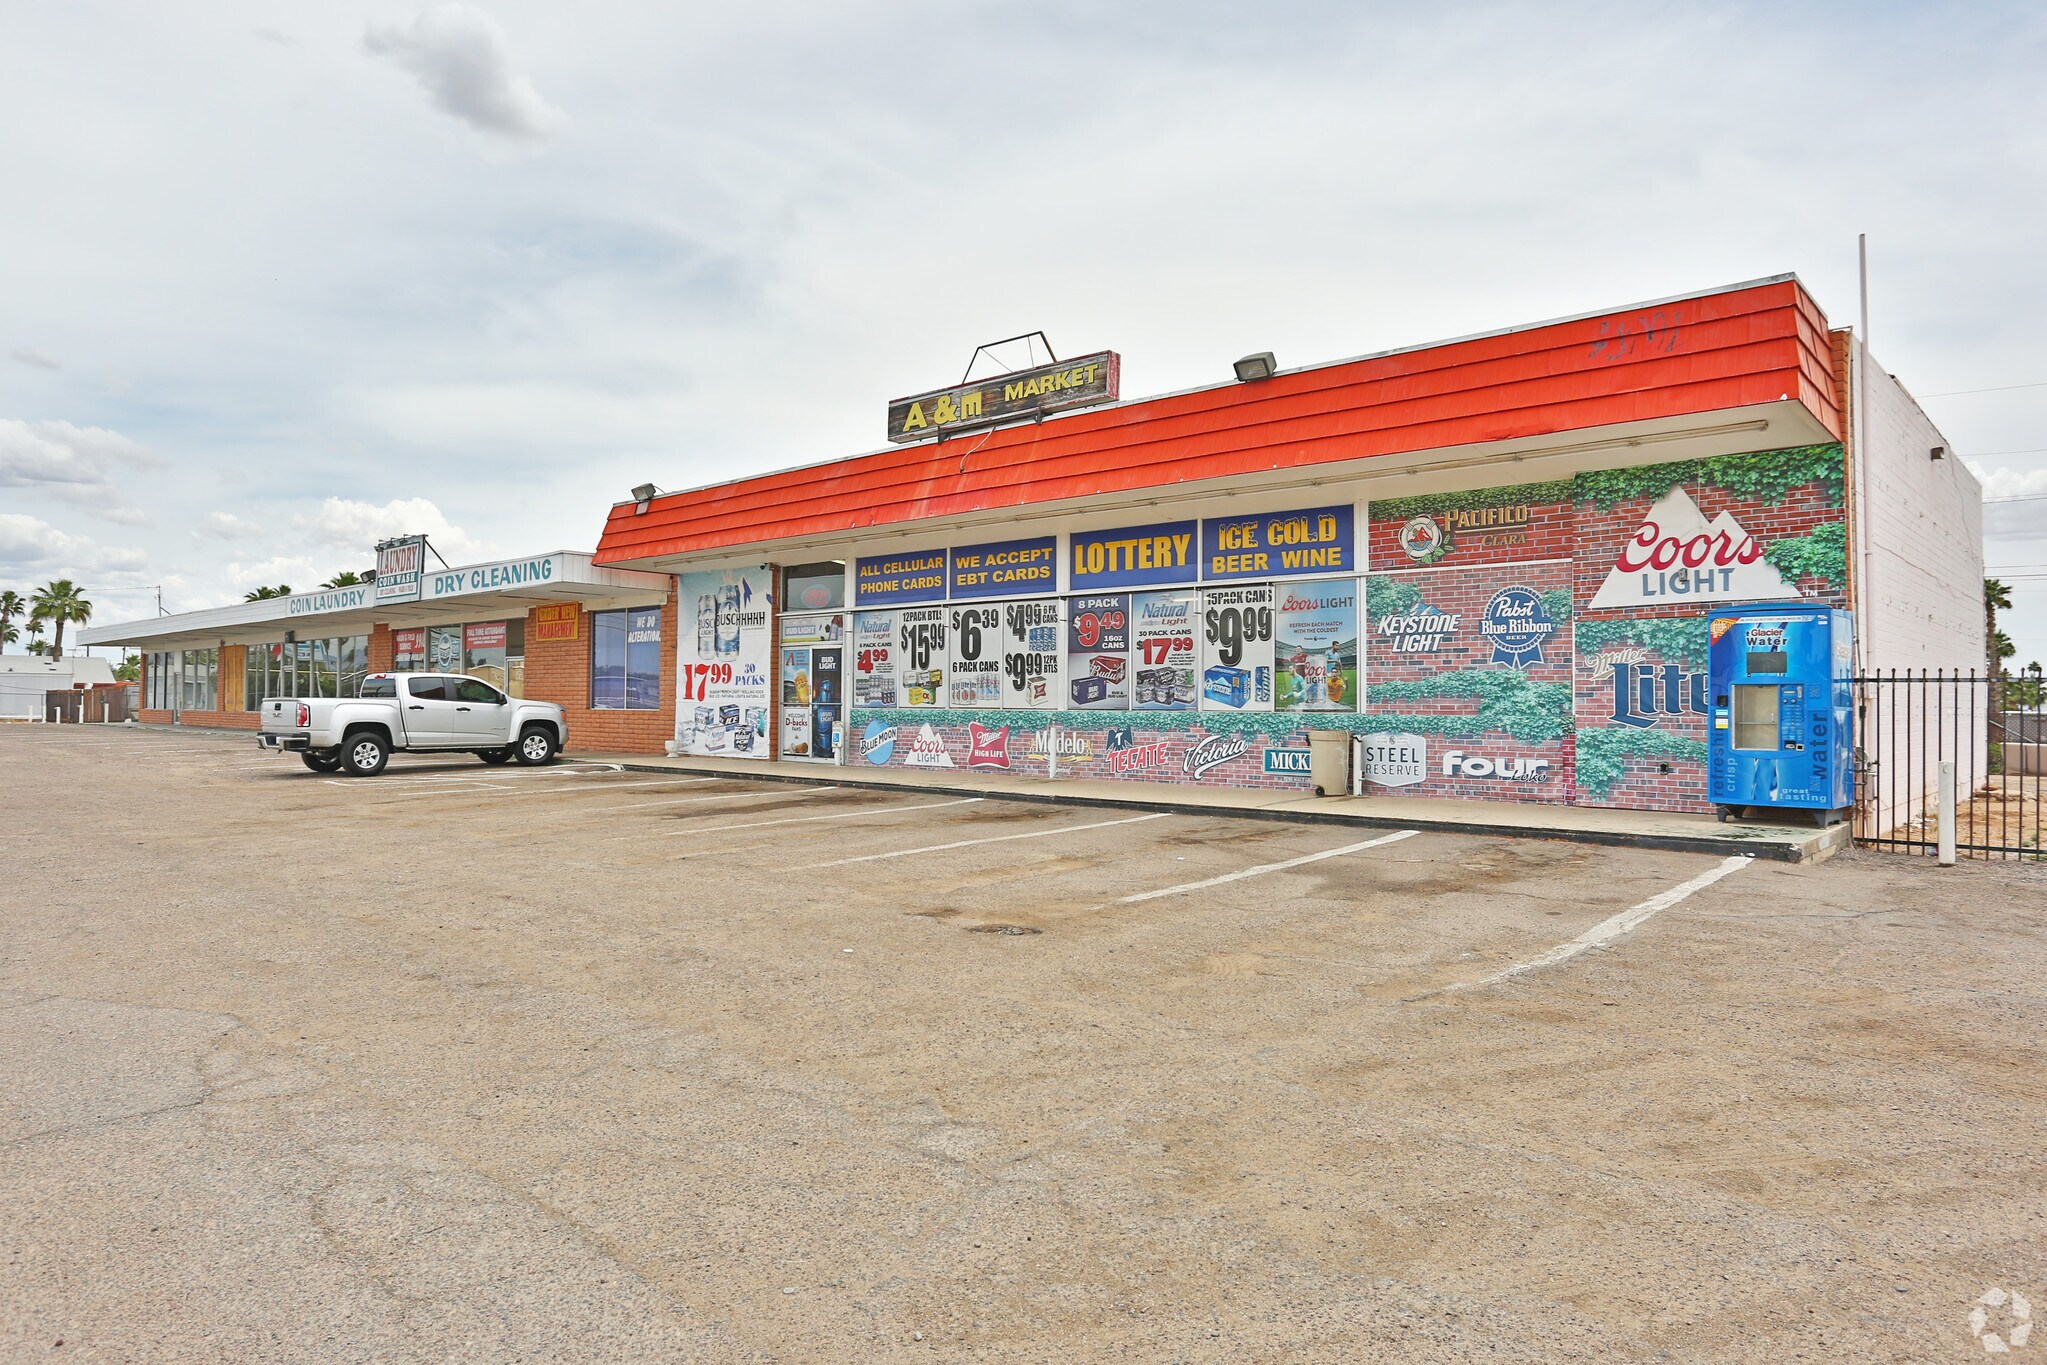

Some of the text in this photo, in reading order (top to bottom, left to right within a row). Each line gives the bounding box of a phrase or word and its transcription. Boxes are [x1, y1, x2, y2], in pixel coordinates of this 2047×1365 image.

[903, 402, 927, 432] A
[1005, 364, 1099, 401] MARKET
[1444, 505, 1528, 531] PACIFICO
[1218, 513, 1336, 550] ICE COLD
[1481, 534, 1527, 547] CLARA
[1075, 534, 1191, 575] LOTTERY
[1614, 521, 1764, 573] Coors
[379, 545, 417, 575] LAUNDRY
[860, 557, 944, 577] ALL CELLULAR
[955, 548, 1053, 569] WE ACCEPT
[1212, 547, 1341, 574] BEER WINE
[379, 573, 415, 586] COIN WASH
[435, 573, 465, 594] DRY
[471, 559, 551, 589] CLEANING
[860, 576, 942, 594] PHONE CARDS
[956, 566, 1051, 586] EBT CARDS
[1641, 568, 1734, 597] LIGHT
[290, 597, 311, 613] COIN
[314, 589, 366, 611] LAUNDRY
[1078, 598, 1119, 609] 8 PACK
[1246, 589, 1272, 603] CANS
[1281, 595, 1354, 612] Coors LIGHT
[561, 604, 576, 619] NEW
[1044, 605, 1056, 614] 6 PK
[1142, 602, 1188, 618] Natural
[1495, 597, 1536, 618] Pabst
[636, 616, 656, 628] WE DO
[860, 619, 891, 633] Natural
[1043, 614, 1058, 623] CANS
[1161, 618, 1188, 626] Light
[1377, 614, 1461, 636] KEYSTONE
[1481, 618, 1553, 636] Blue Ribbon
[466, 628, 475, 636] FULL
[476, 628, 484, 636] TIME
[538, 622, 574, 638] MANAGEMENT
[798, 626, 815, 634] LIGHT
[1751, 628, 1783, 637] Glacier
[1392, 633, 1445, 653] LIGHT
[1746, 637, 1788, 646] Water
[744, 663, 756, 674] 30
[952, 661, 999, 673] 6 PACK CANS
[1044, 664, 1058, 673] BTLS
[1585, 648, 1648, 681] Miller
[735, 675, 765, 686] PACKS
[785, 718, 808, 727] D-backs
[860, 729, 896, 755] BLUE MOON
[911, 733, 946, 753] Coors
[976, 731, 1003, 748] Miller
[1810, 713, 1827, 781] water
[917, 753, 940, 763] LIGHT
[990, 750, 1003, 758] LIFE
[1107, 741, 1170, 774] TECATE
[1183, 735, 1249, 780] Victoria
[1270, 752, 1312, 770] MICK
[1366, 746, 1420, 764] STEEL
[1365, 764, 1420, 776] RESERVE
[1443, 750, 1549, 779] four
[1711, 731, 1724, 796] refreshi
[1511, 768, 1548, 783] Loko
[1725, 758, 1738, 792] crisp
[1780, 793, 1827, 803] tasting
